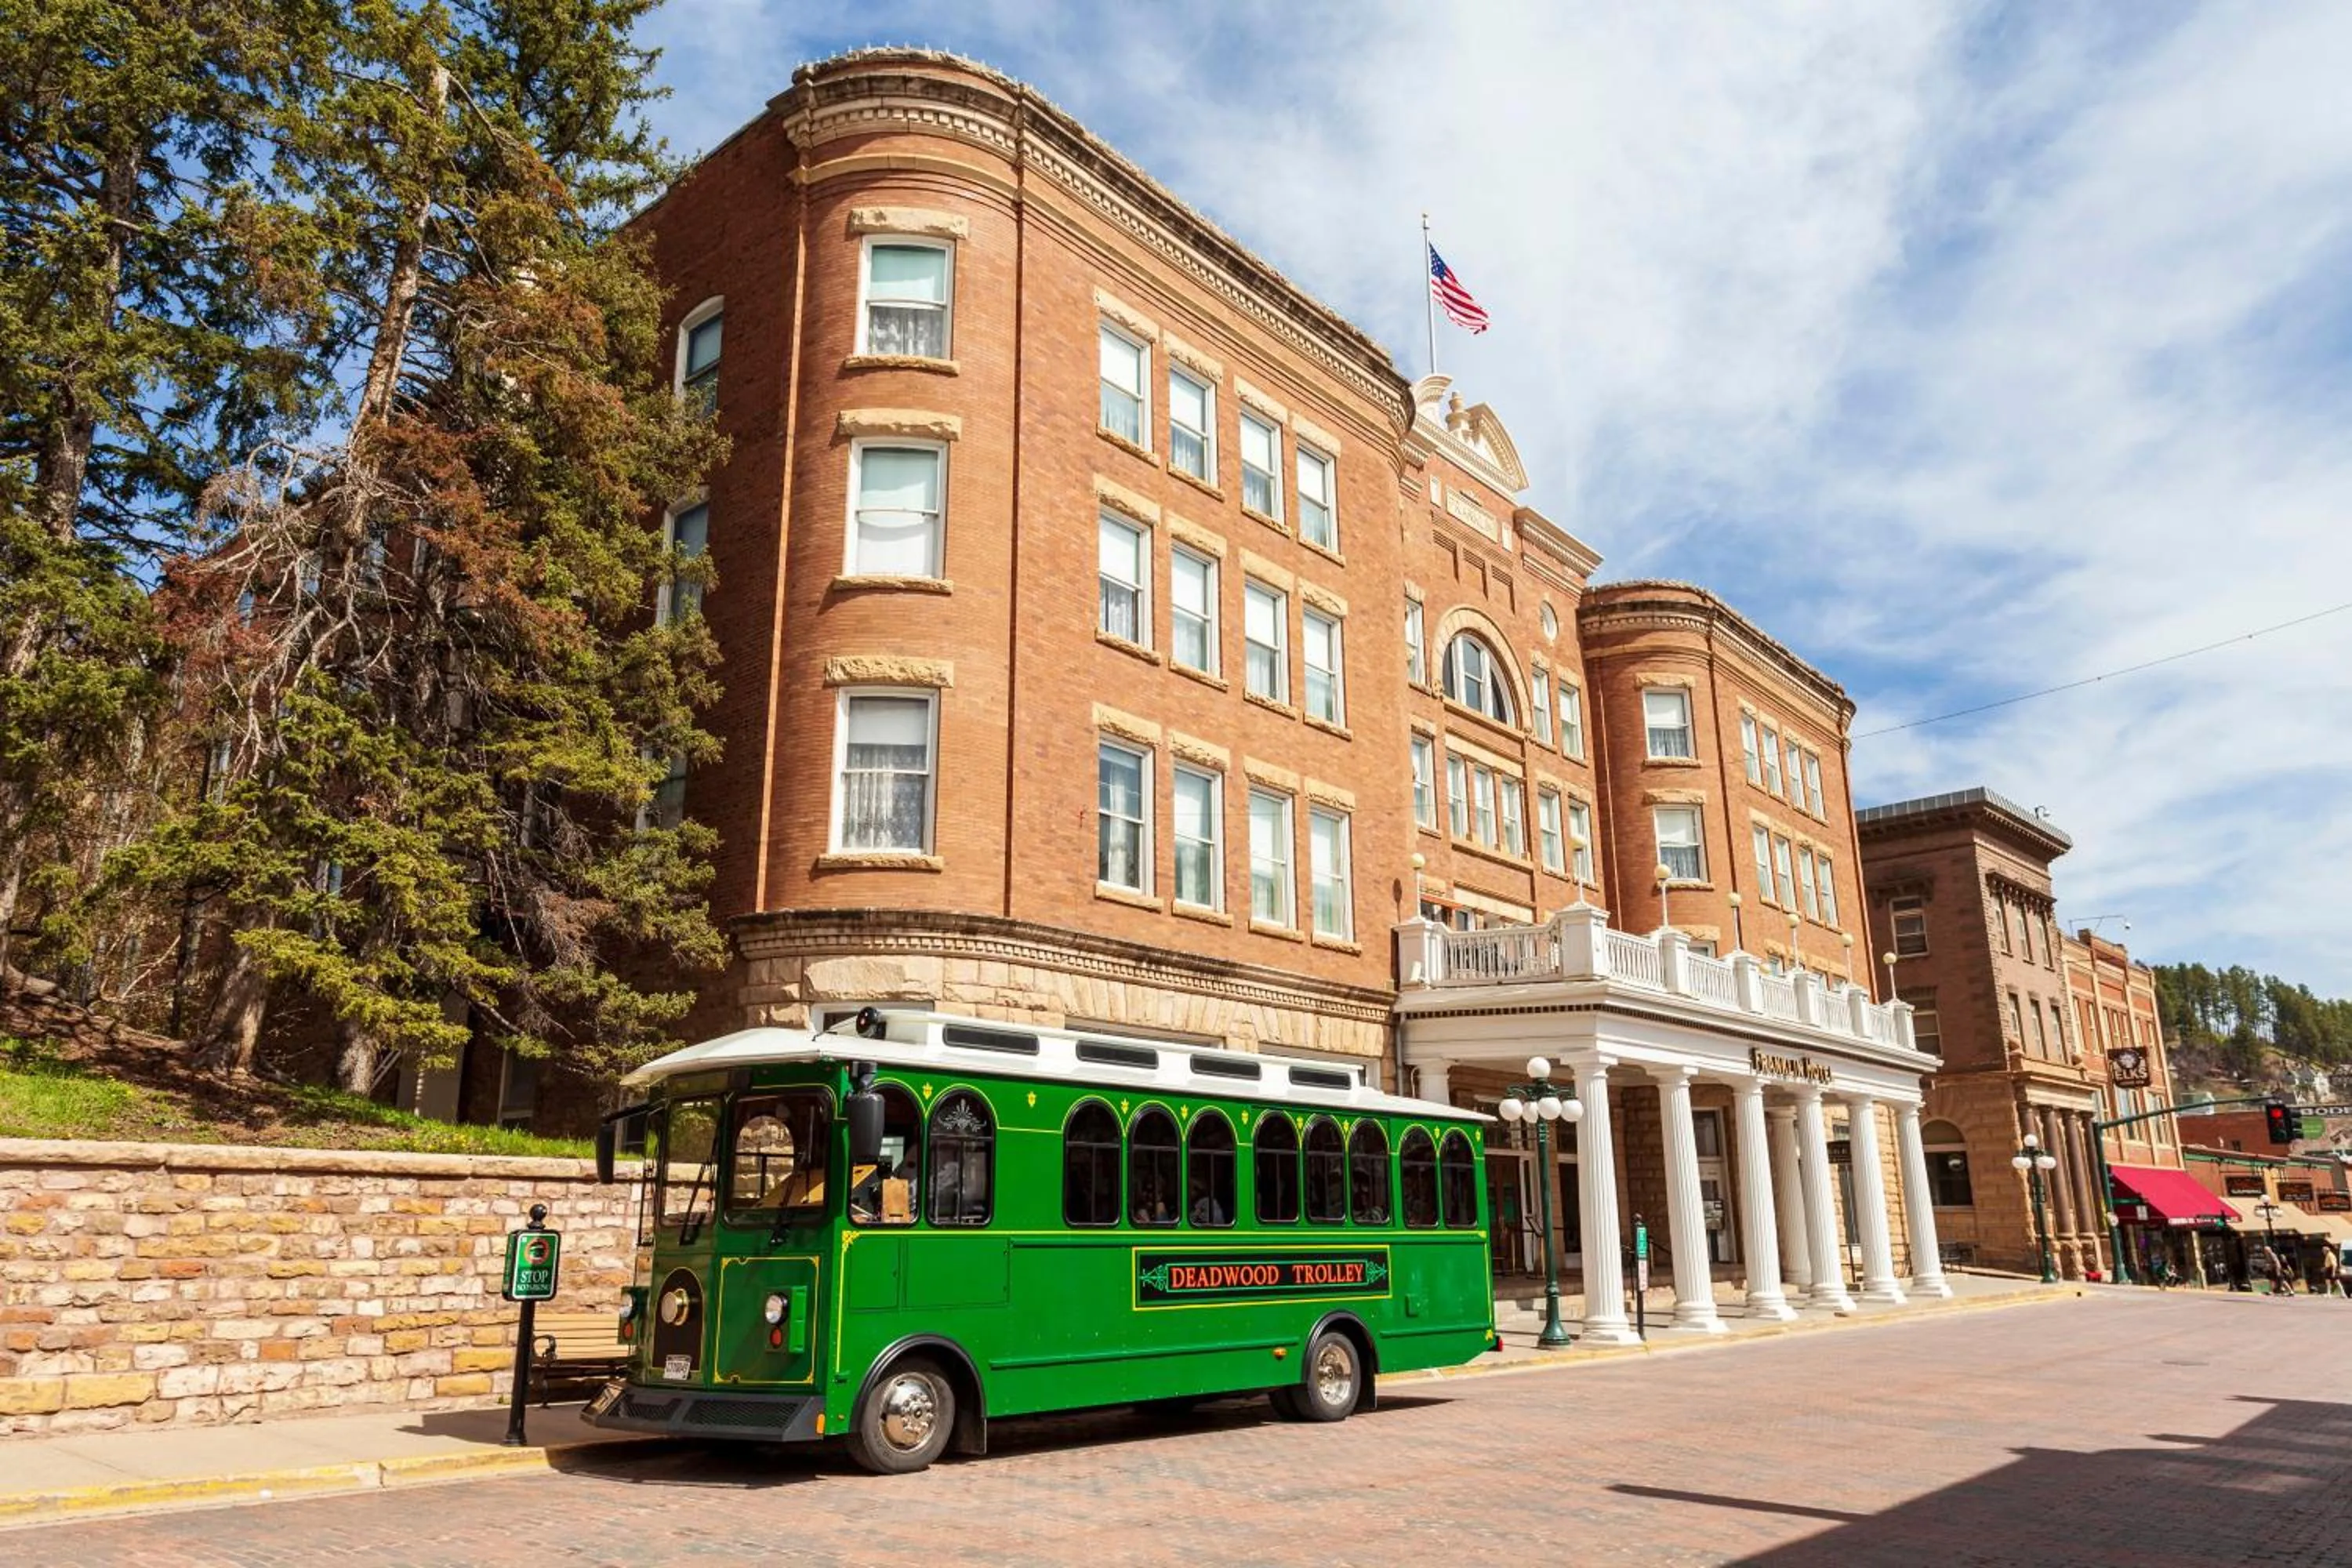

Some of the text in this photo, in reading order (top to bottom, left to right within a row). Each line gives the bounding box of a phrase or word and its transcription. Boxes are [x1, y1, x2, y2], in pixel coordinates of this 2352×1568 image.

[2114, 1067, 2147, 1080] ELKS
[520, 1269, 549, 1283] STOP
[1171, 1263, 1364, 1288] DEADWOOD TROLLEY
